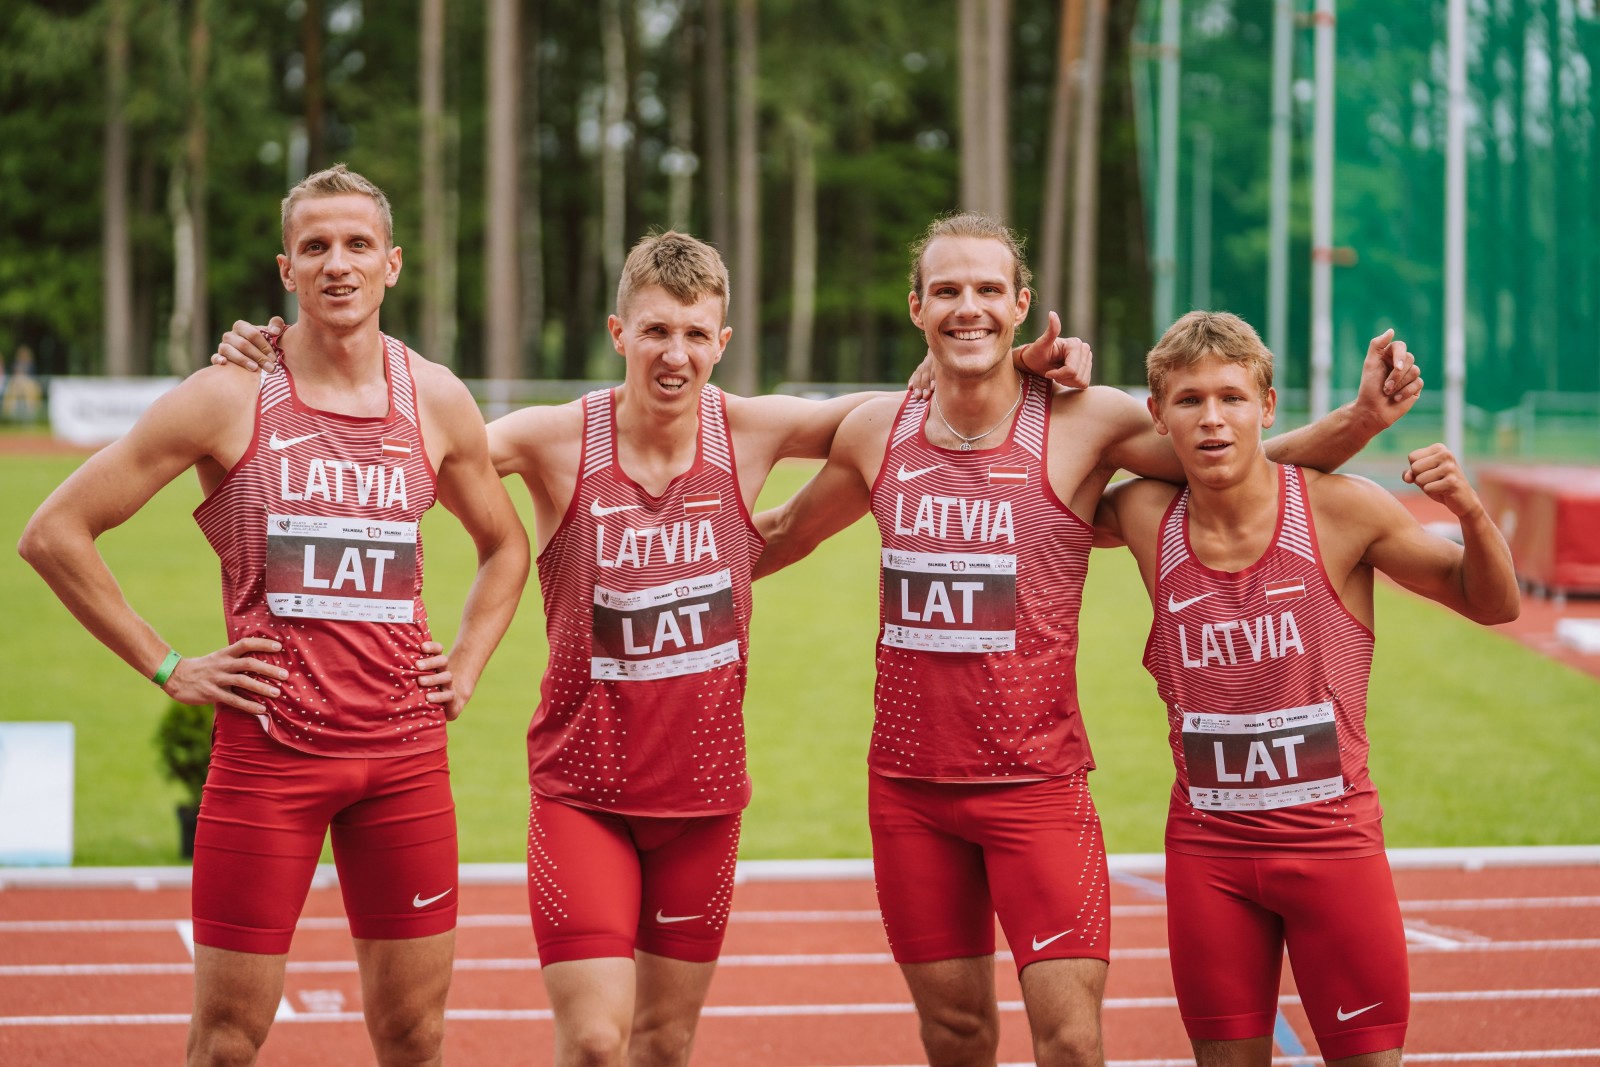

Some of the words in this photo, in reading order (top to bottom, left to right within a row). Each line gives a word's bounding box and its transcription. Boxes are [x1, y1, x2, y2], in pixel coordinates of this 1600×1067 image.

[280, 457, 408, 511] LATVIA
[894, 492, 1016, 544] LATVIA
[303, 544, 395, 593] LAT
[596, 519, 719, 568] LATVIA
[901, 578, 984, 624] LAT
[621, 602, 710, 655] LAT
[1178, 610, 1305, 668] LATVIA
[1213, 734, 1305, 783] LAT
